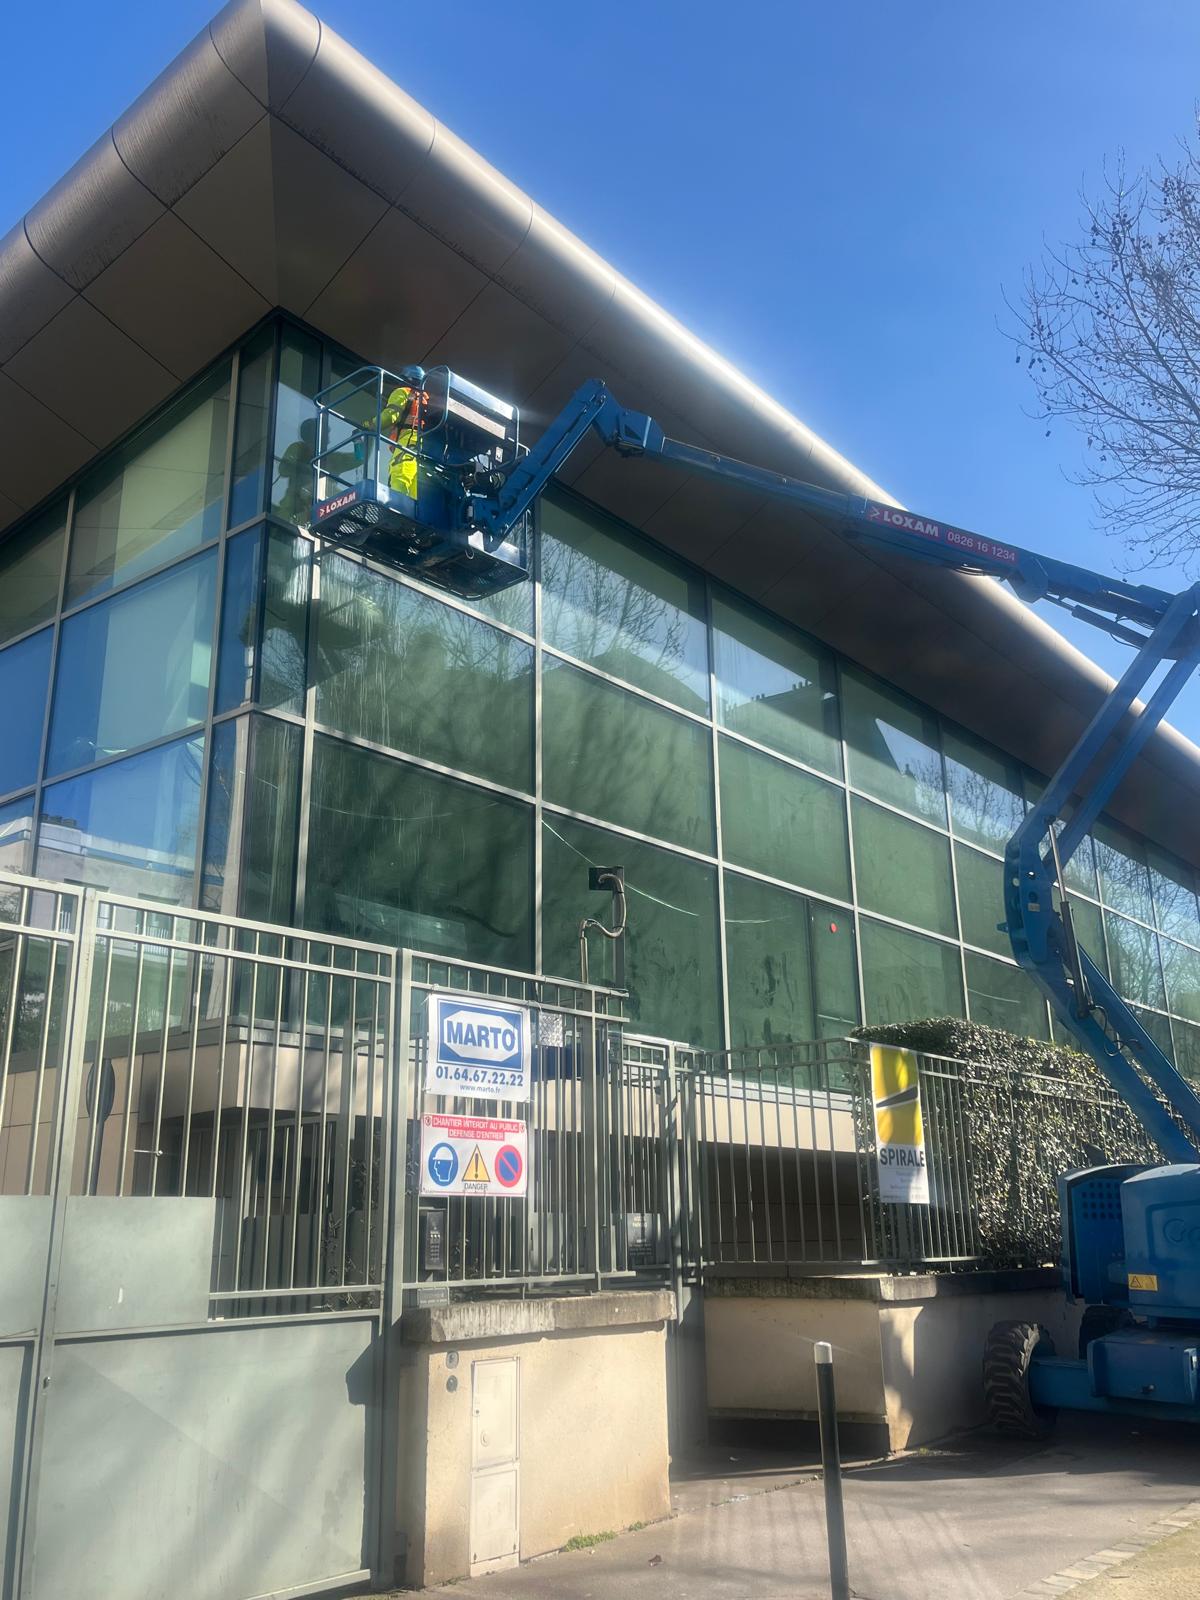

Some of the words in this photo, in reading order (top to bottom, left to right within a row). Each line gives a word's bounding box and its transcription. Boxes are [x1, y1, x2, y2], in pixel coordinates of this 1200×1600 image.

[326, 492, 356, 513] LOXAM
[883, 510, 939, 537] LOXAM
[947, 531, 974, 548] 0826
[977, 541, 988, 553] 16
[991, 546, 1016, 561] 1234
[446, 1020, 516, 1052] MARTO
[435, 1065, 524, 1087] 01.64.67.22.22
[460, 1084, 501, 1094] www.marto.fr
[433, 1116, 461, 1127] CHANTIER
[464, 1118, 488, 1129] INTERDIT
[490, 1121, 498, 1129] AU
[499, 1122, 519, 1132] PUBLIC
[880, 1148, 925, 1167] SPIRALE
[464, 1182, 488, 1191] DANGER
